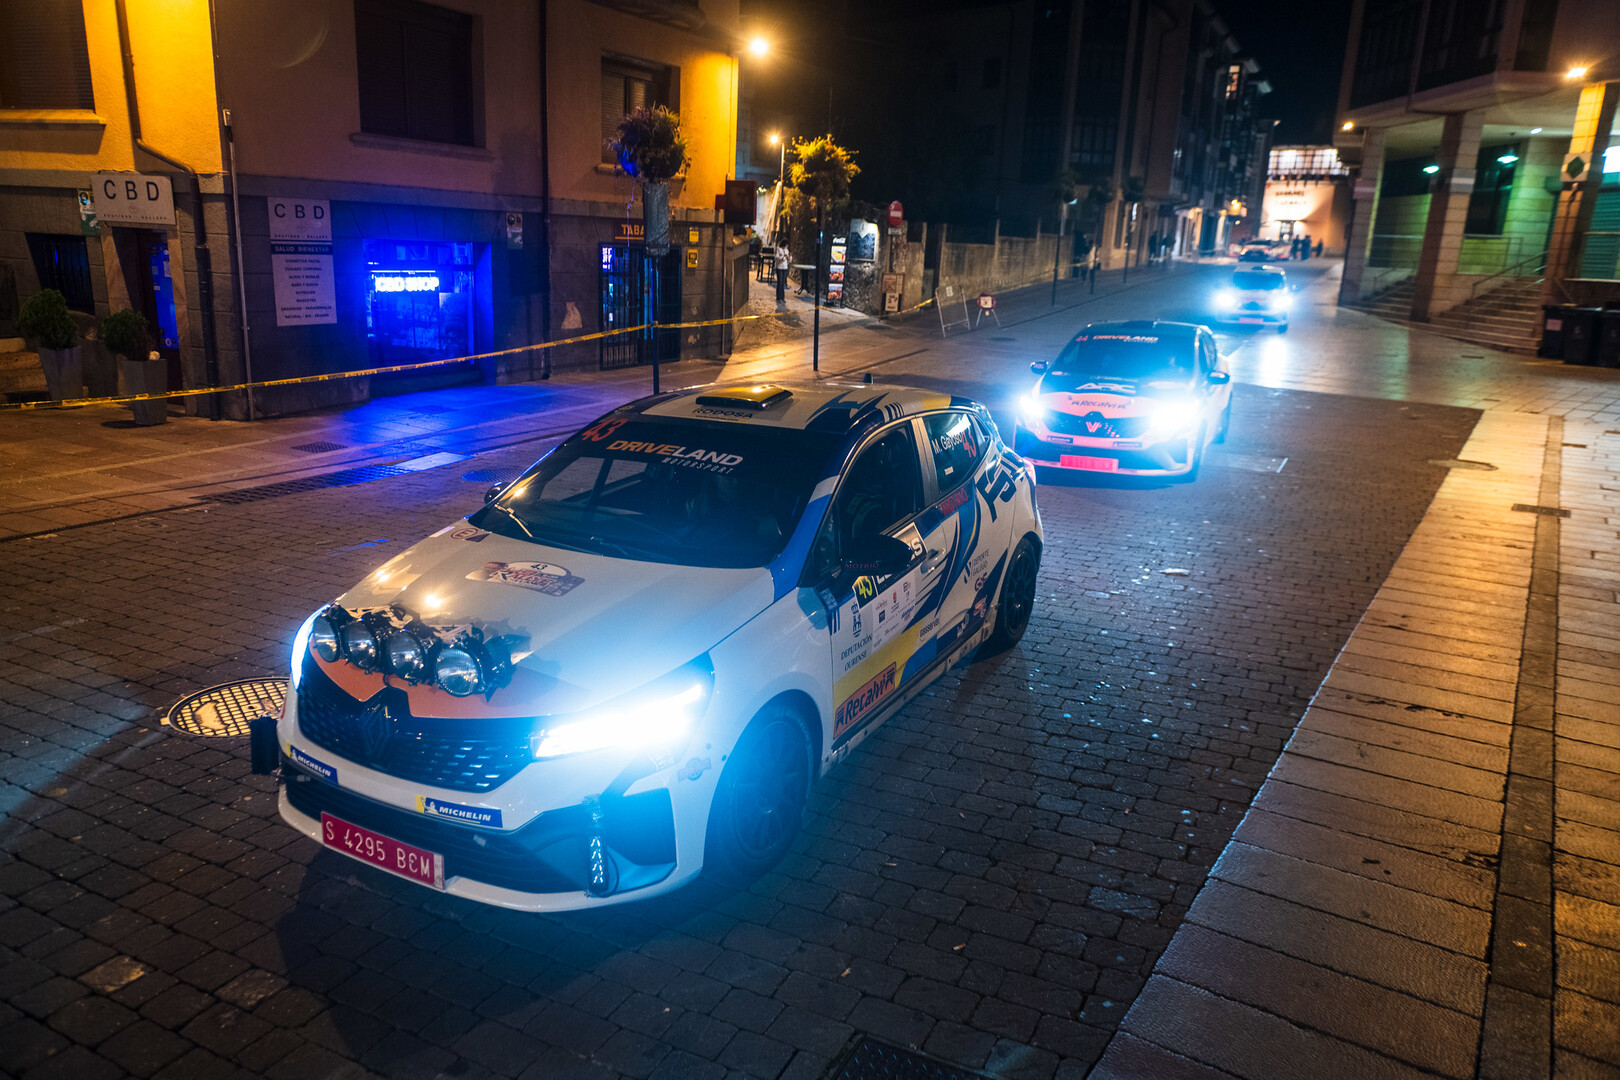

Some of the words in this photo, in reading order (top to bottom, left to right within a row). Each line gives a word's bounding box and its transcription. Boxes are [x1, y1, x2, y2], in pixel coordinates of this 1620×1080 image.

[103, 179, 159, 201] CBD
[274, 203, 325, 220] CBD
[621, 224, 644, 235] TABA
[1092, 335, 1159, 344] DRIVELAND
[692, 407, 753, 419] RODOSA
[582, 418, 629, 442] 43
[606, 440, 744, 466] DRIVELAND
[931, 438, 943, 454] M.
[940, 431, 963, 451] Gayoso
[961, 426, 977, 458] 43
[661, 457, 735, 475] MOTORSPORT
[530, 563, 548, 571] 43
[858, 575, 873, 599] 43
[840, 632, 873, 660] DEPUTACIÓN
[844, 651, 867, 671] OURENSE
[297, 754, 332, 777] MICHELIN
[438, 805, 492, 822] MICHELIN
[325, 820, 335, 841] S
[344, 828, 386, 861] 4295
[396, 848, 430, 878] BCM
